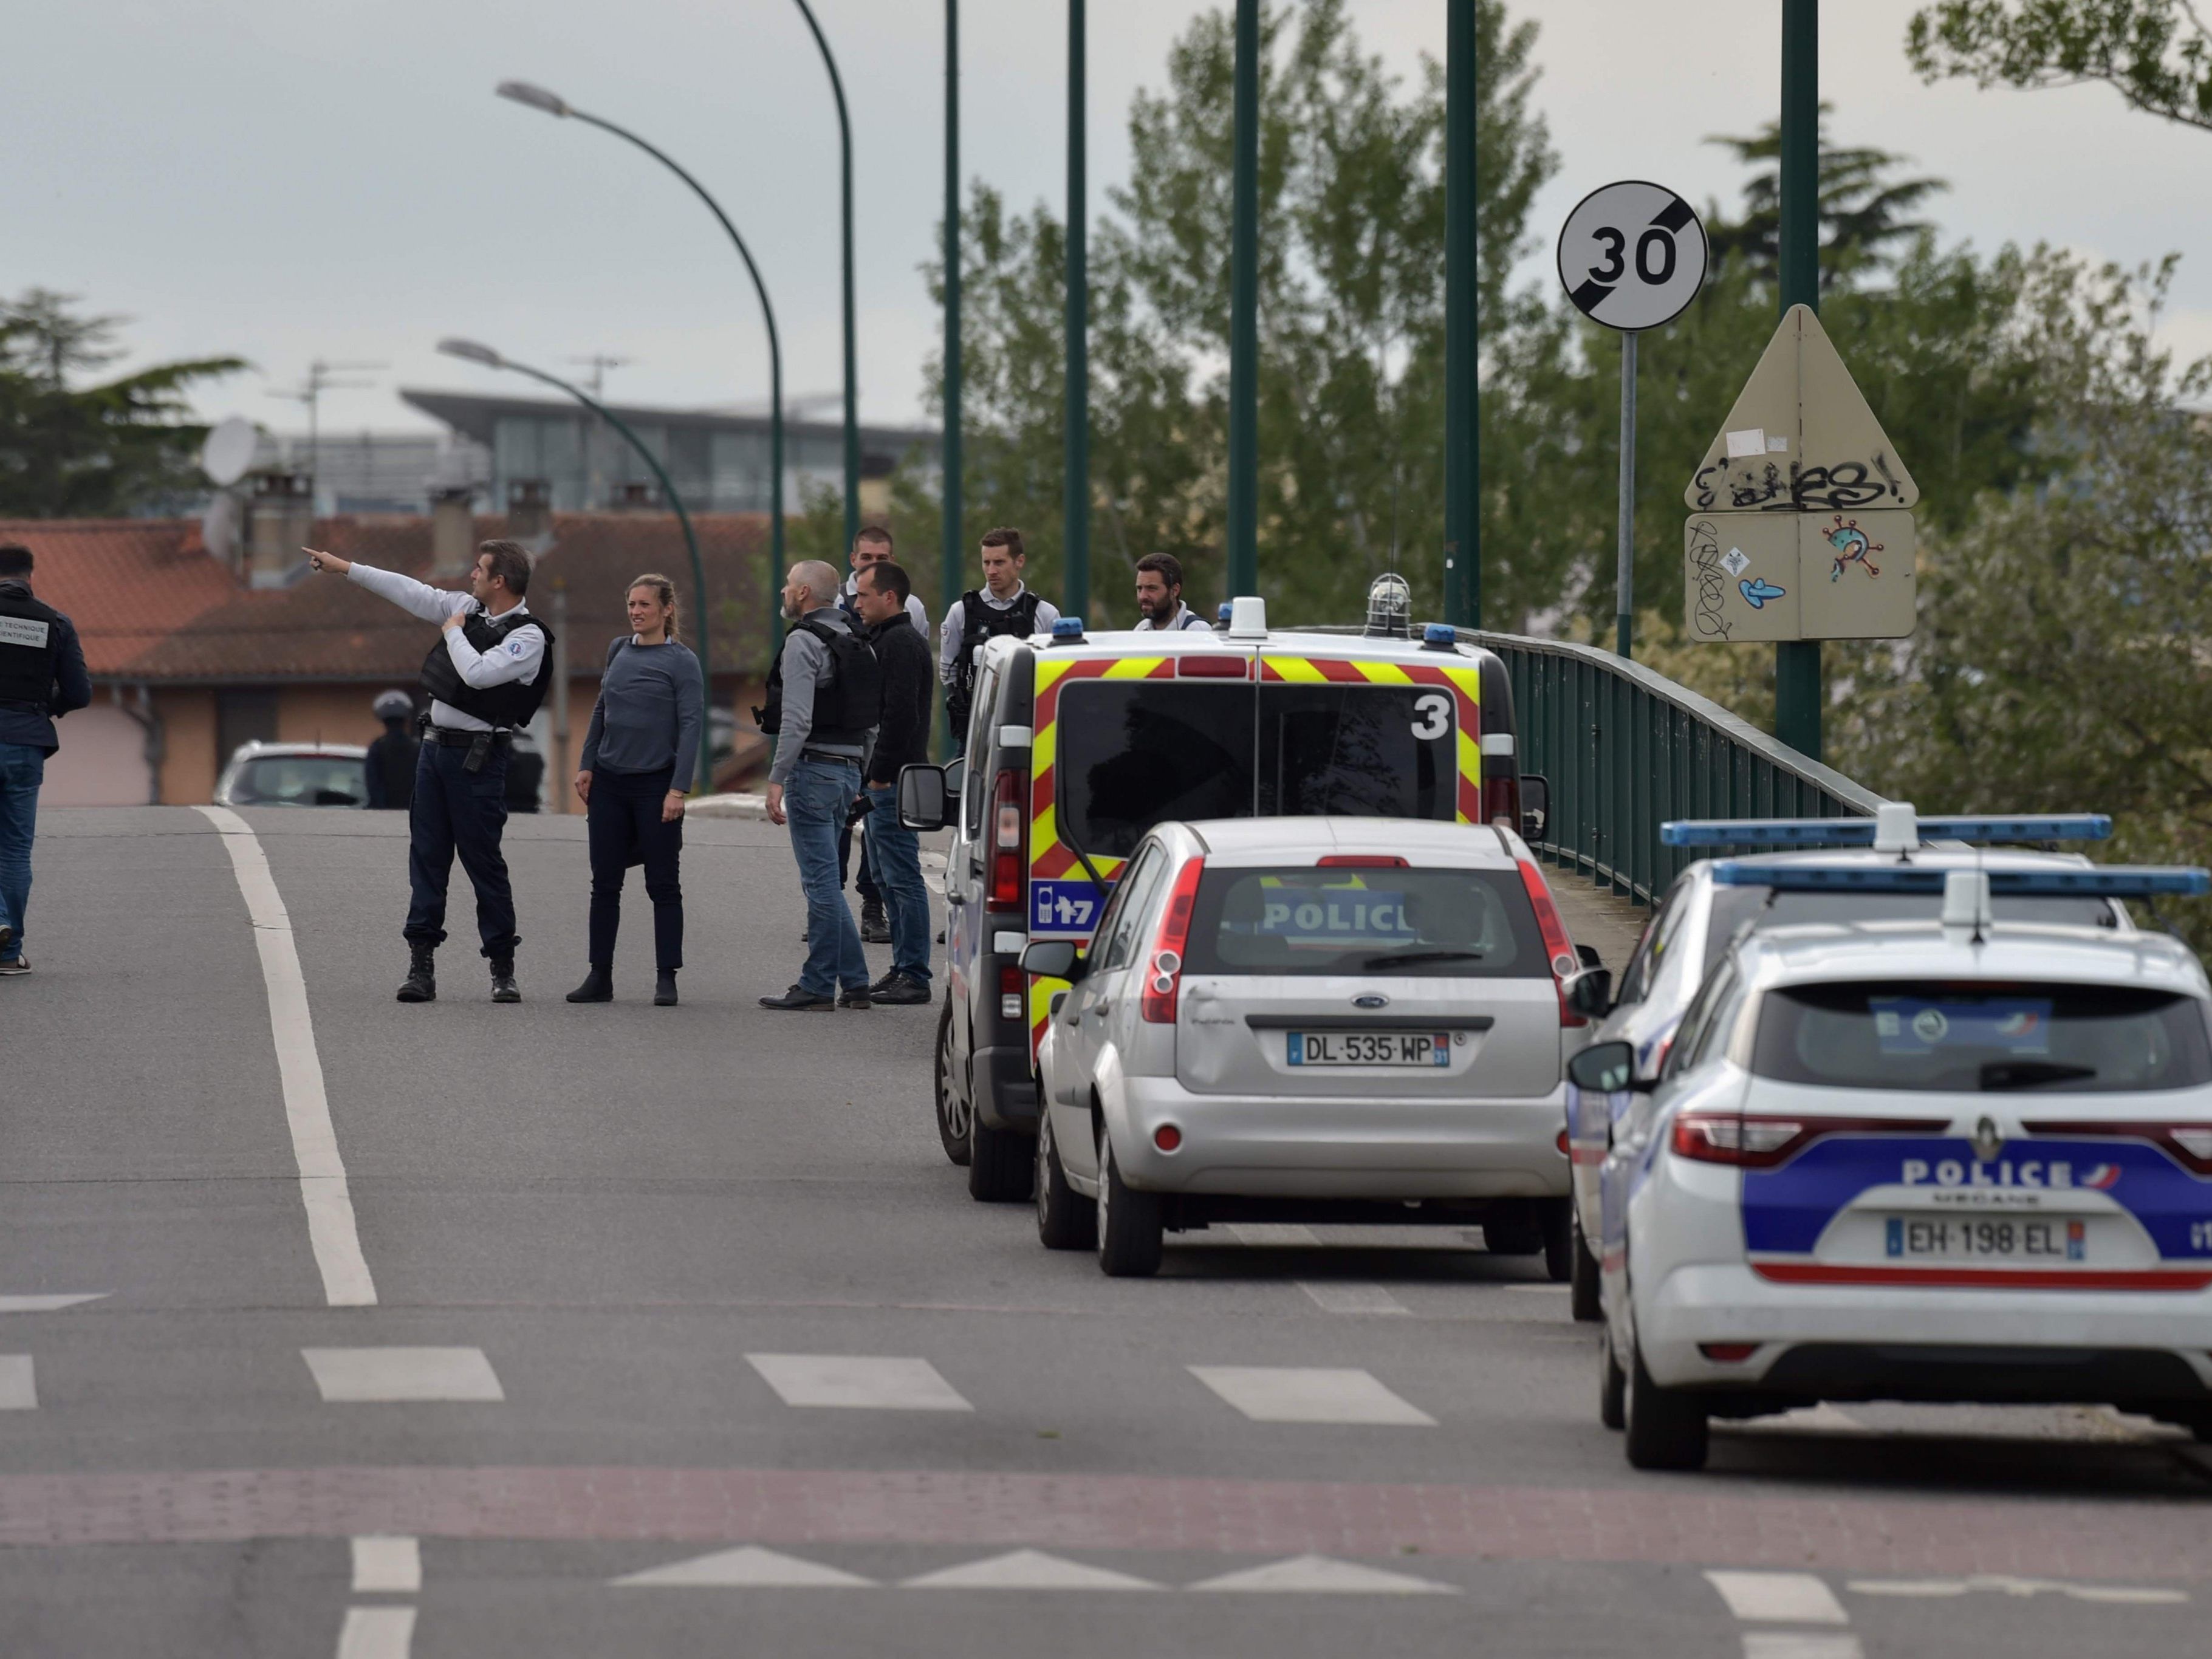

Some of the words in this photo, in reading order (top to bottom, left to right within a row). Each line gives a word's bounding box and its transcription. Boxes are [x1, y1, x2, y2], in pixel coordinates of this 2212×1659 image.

[1589, 227, 1676, 285] 30
[4, 622, 45, 633] TECHNIQUE
[1411, 694, 1451, 740] 3
[1902, 1158, 2072, 1187] POLICE
